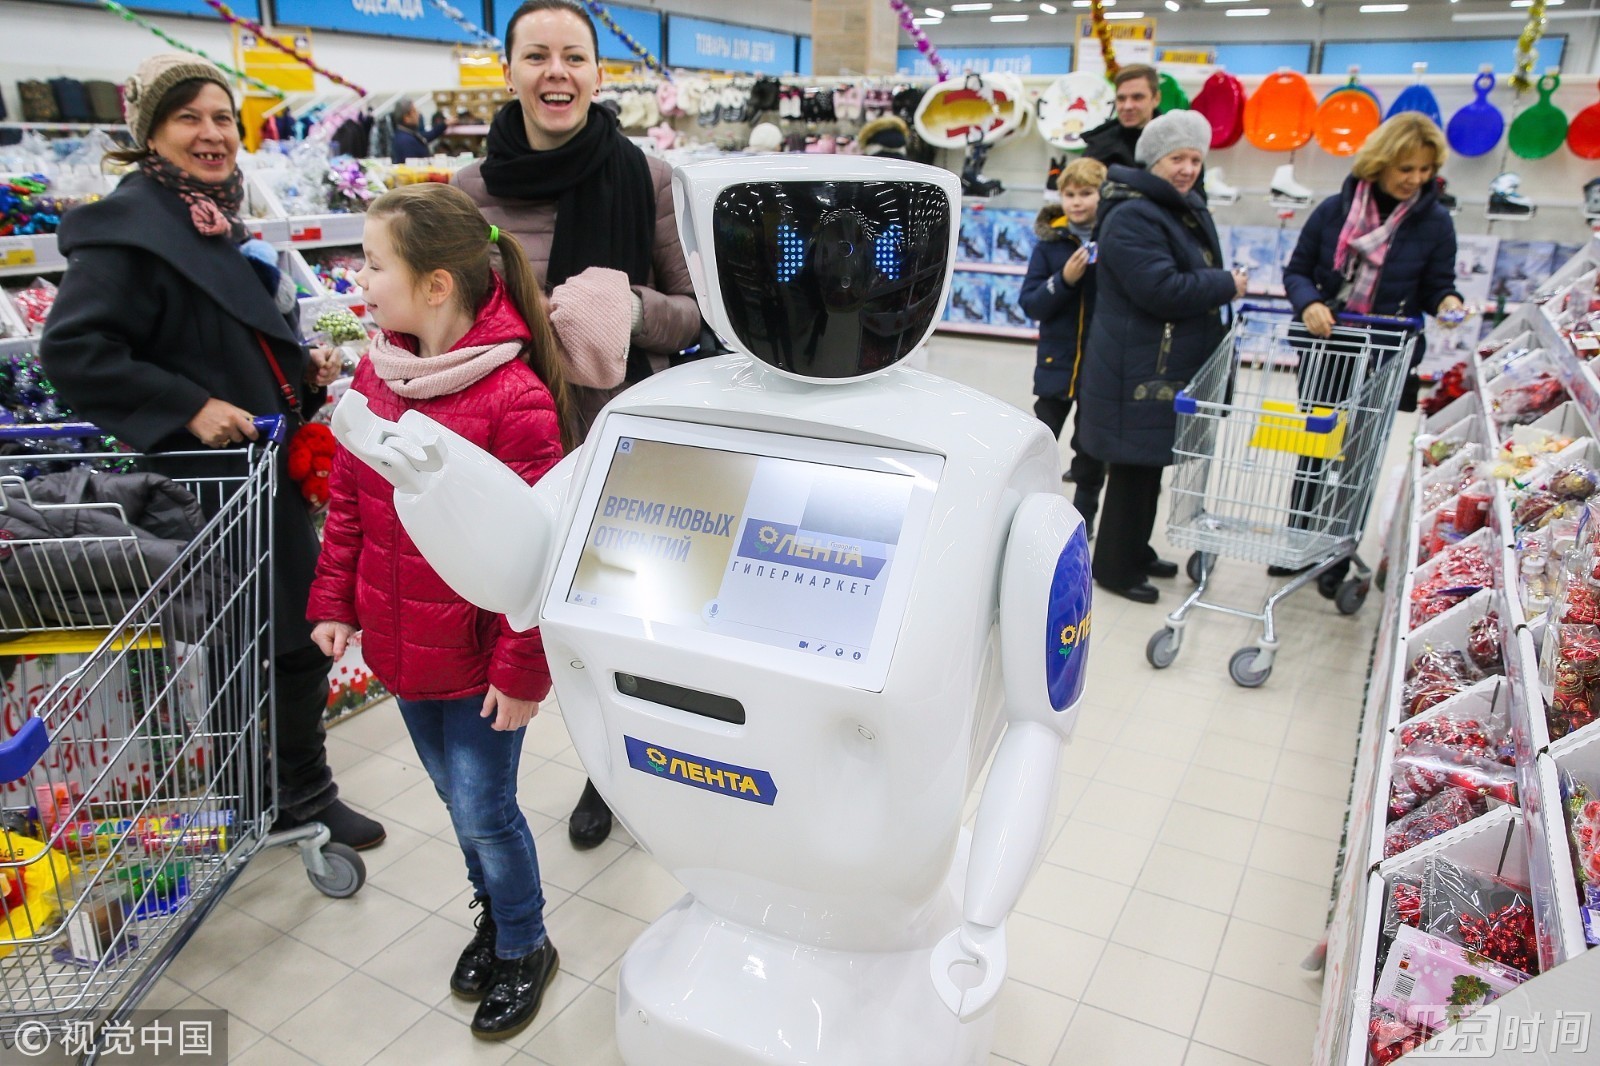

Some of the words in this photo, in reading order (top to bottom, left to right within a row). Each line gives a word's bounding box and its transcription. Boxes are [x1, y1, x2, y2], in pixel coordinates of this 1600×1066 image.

[352, 0, 425, 20] ОДЕЖДА
[603, 495, 666, 526] ВРЕМЯ
[665, 505, 735, 538] НОВЫХ
[593, 525, 692, 563] ОТКРЫТИЙ
[773, 533, 863, 568] ЛЕНТА
[731, 561, 871, 596] ГИПЕРМАРКЕТ
[669, 757, 761, 797] ЛЕНТА
